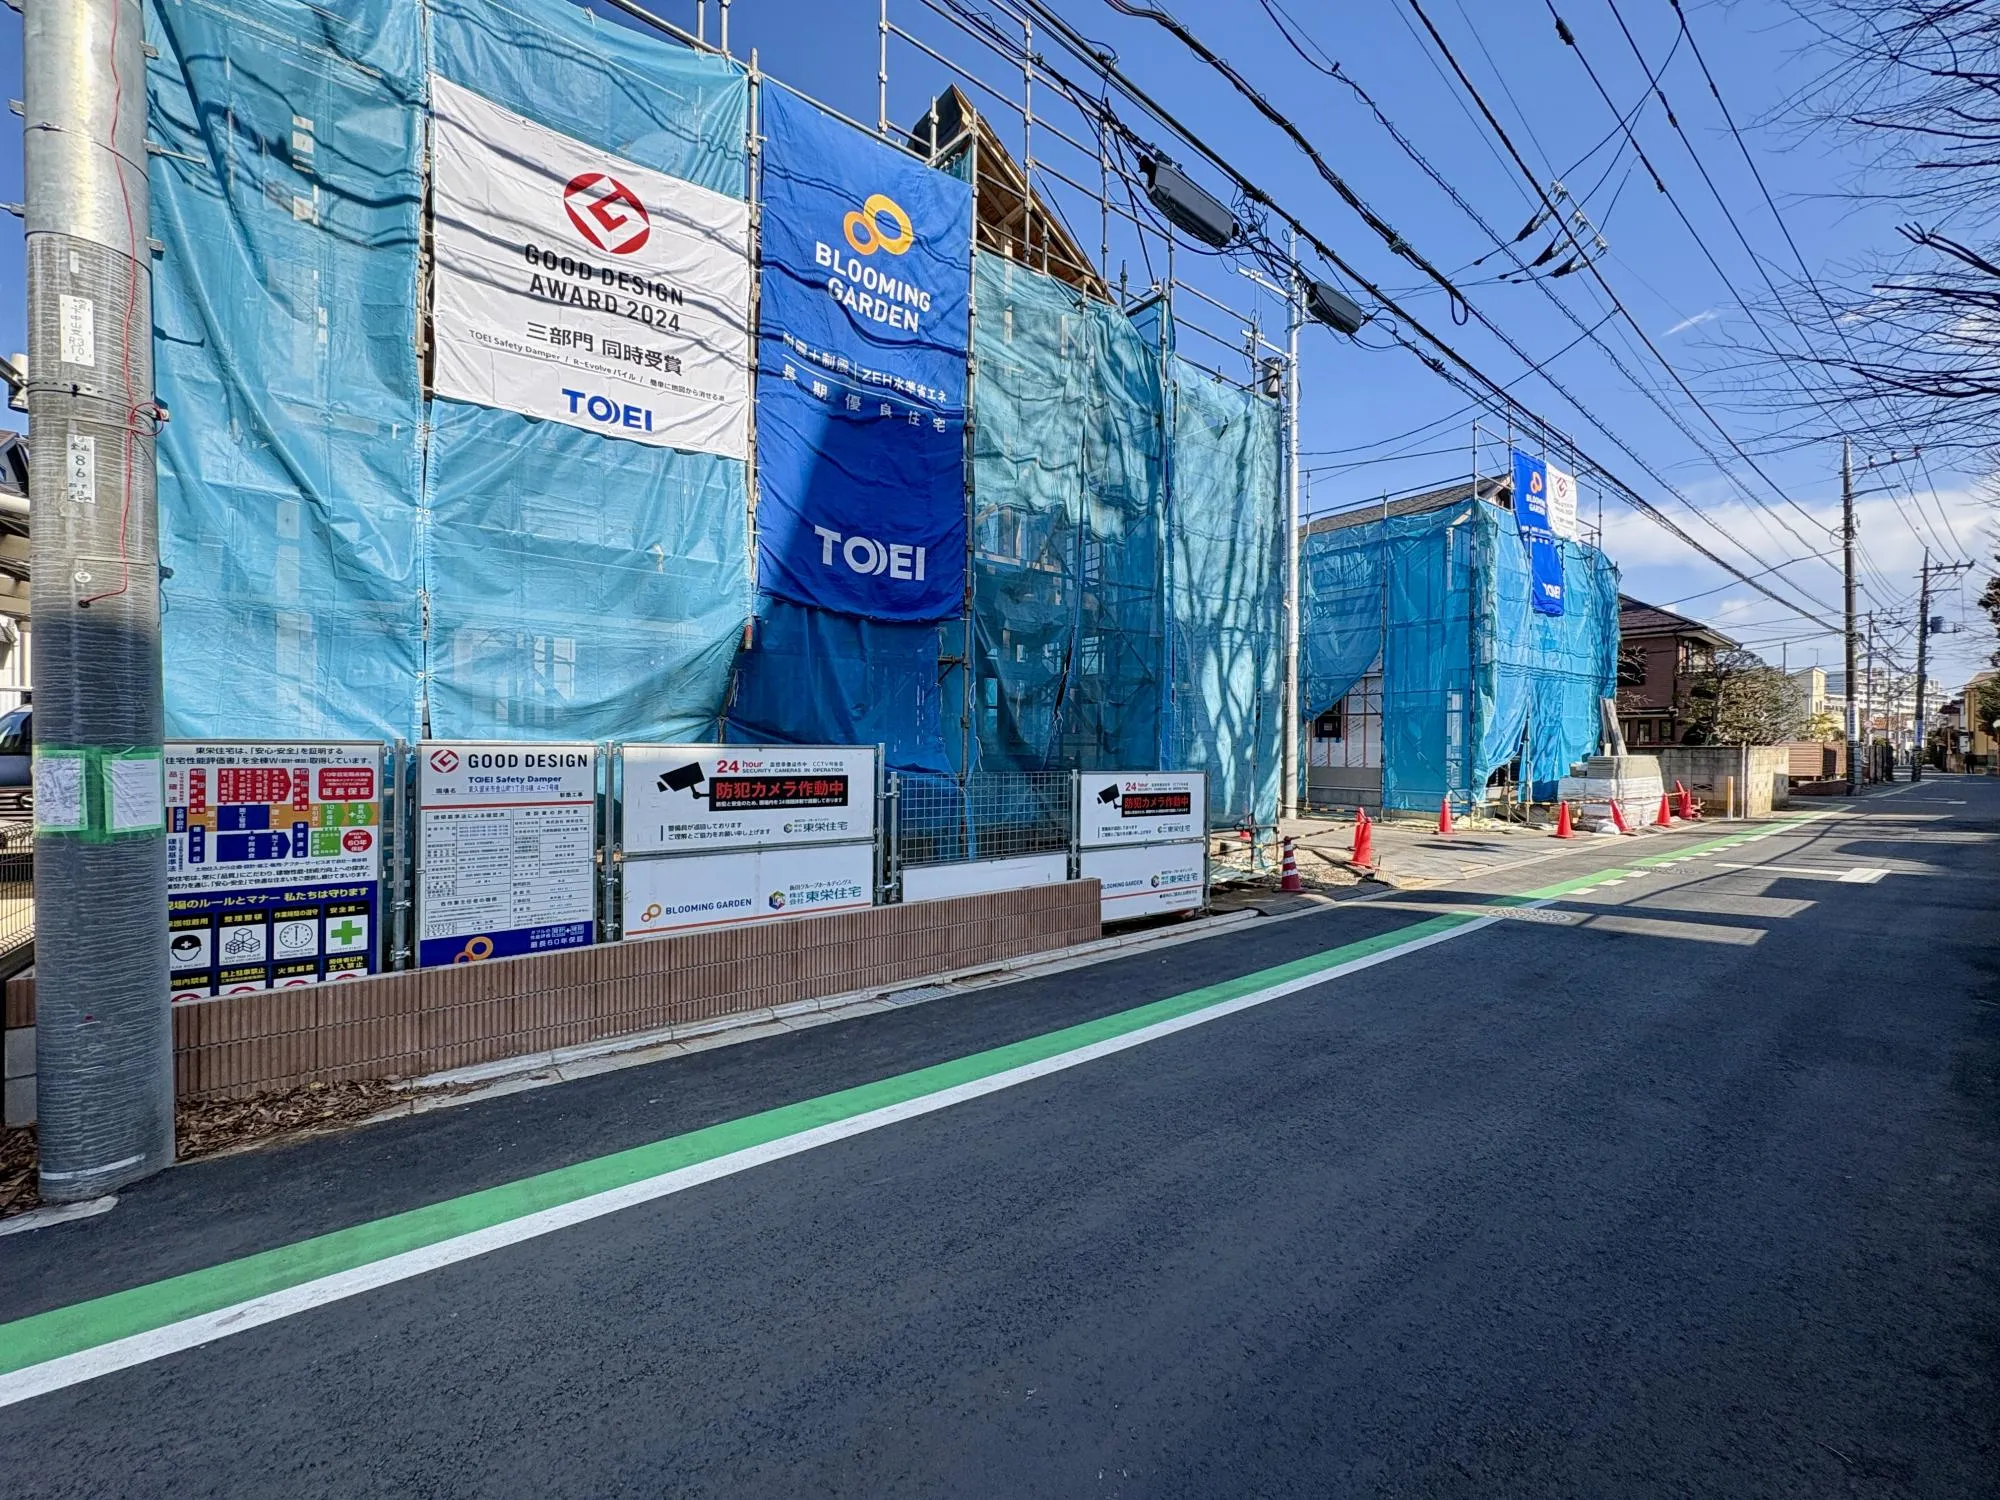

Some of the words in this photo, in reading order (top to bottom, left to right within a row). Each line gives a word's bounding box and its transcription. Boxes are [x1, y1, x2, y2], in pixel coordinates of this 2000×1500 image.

[525, 243, 592, 281] GOOD
[601, 267, 684, 307] DESIGN
[815, 240, 931, 313] BLOOMING
[529, 273, 618, 315] AWARD
[627, 300, 680, 332] 2024
[827, 276, 920, 334] GARDEN
[469, 329, 493, 343] TOEI
[494, 336, 524, 354] Safety
[525, 345, 561, 362] Damper
[573, 358, 612, 374] R-Evolve
[613, 369, 637, 382] パイル
[526, 320, 592, 350] 三部門
[602, 337, 683, 377] 同時受賞
[781, 363, 946, 434] 長期優良住宅
[561, 387, 653, 432] TOEI
[814, 524, 926, 581] TOEI
[468, 754, 518, 769] GOOD
[525, 754, 588, 768] DESIGN
[716, 760, 740, 774] 24
[742, 760, 764, 768] hour
[496, 776, 525, 784] Safety
[527, 775, 562, 783] Damper
[1125, 781, 1137, 792] 24
[715, 780, 844, 799] 防犯カメラ作動中
[803, 821, 849, 833] 東栄住宅
[1169, 872, 1198, 883] 東栄住宅
[284, 887, 369, 902] 私たちは守ります
[805, 886, 862, 902] 東栄住宅
[329, 905, 366, 914] 安全第一
[665, 901, 714, 915] BLOOMING
[716, 898, 752, 911] GARDEN
